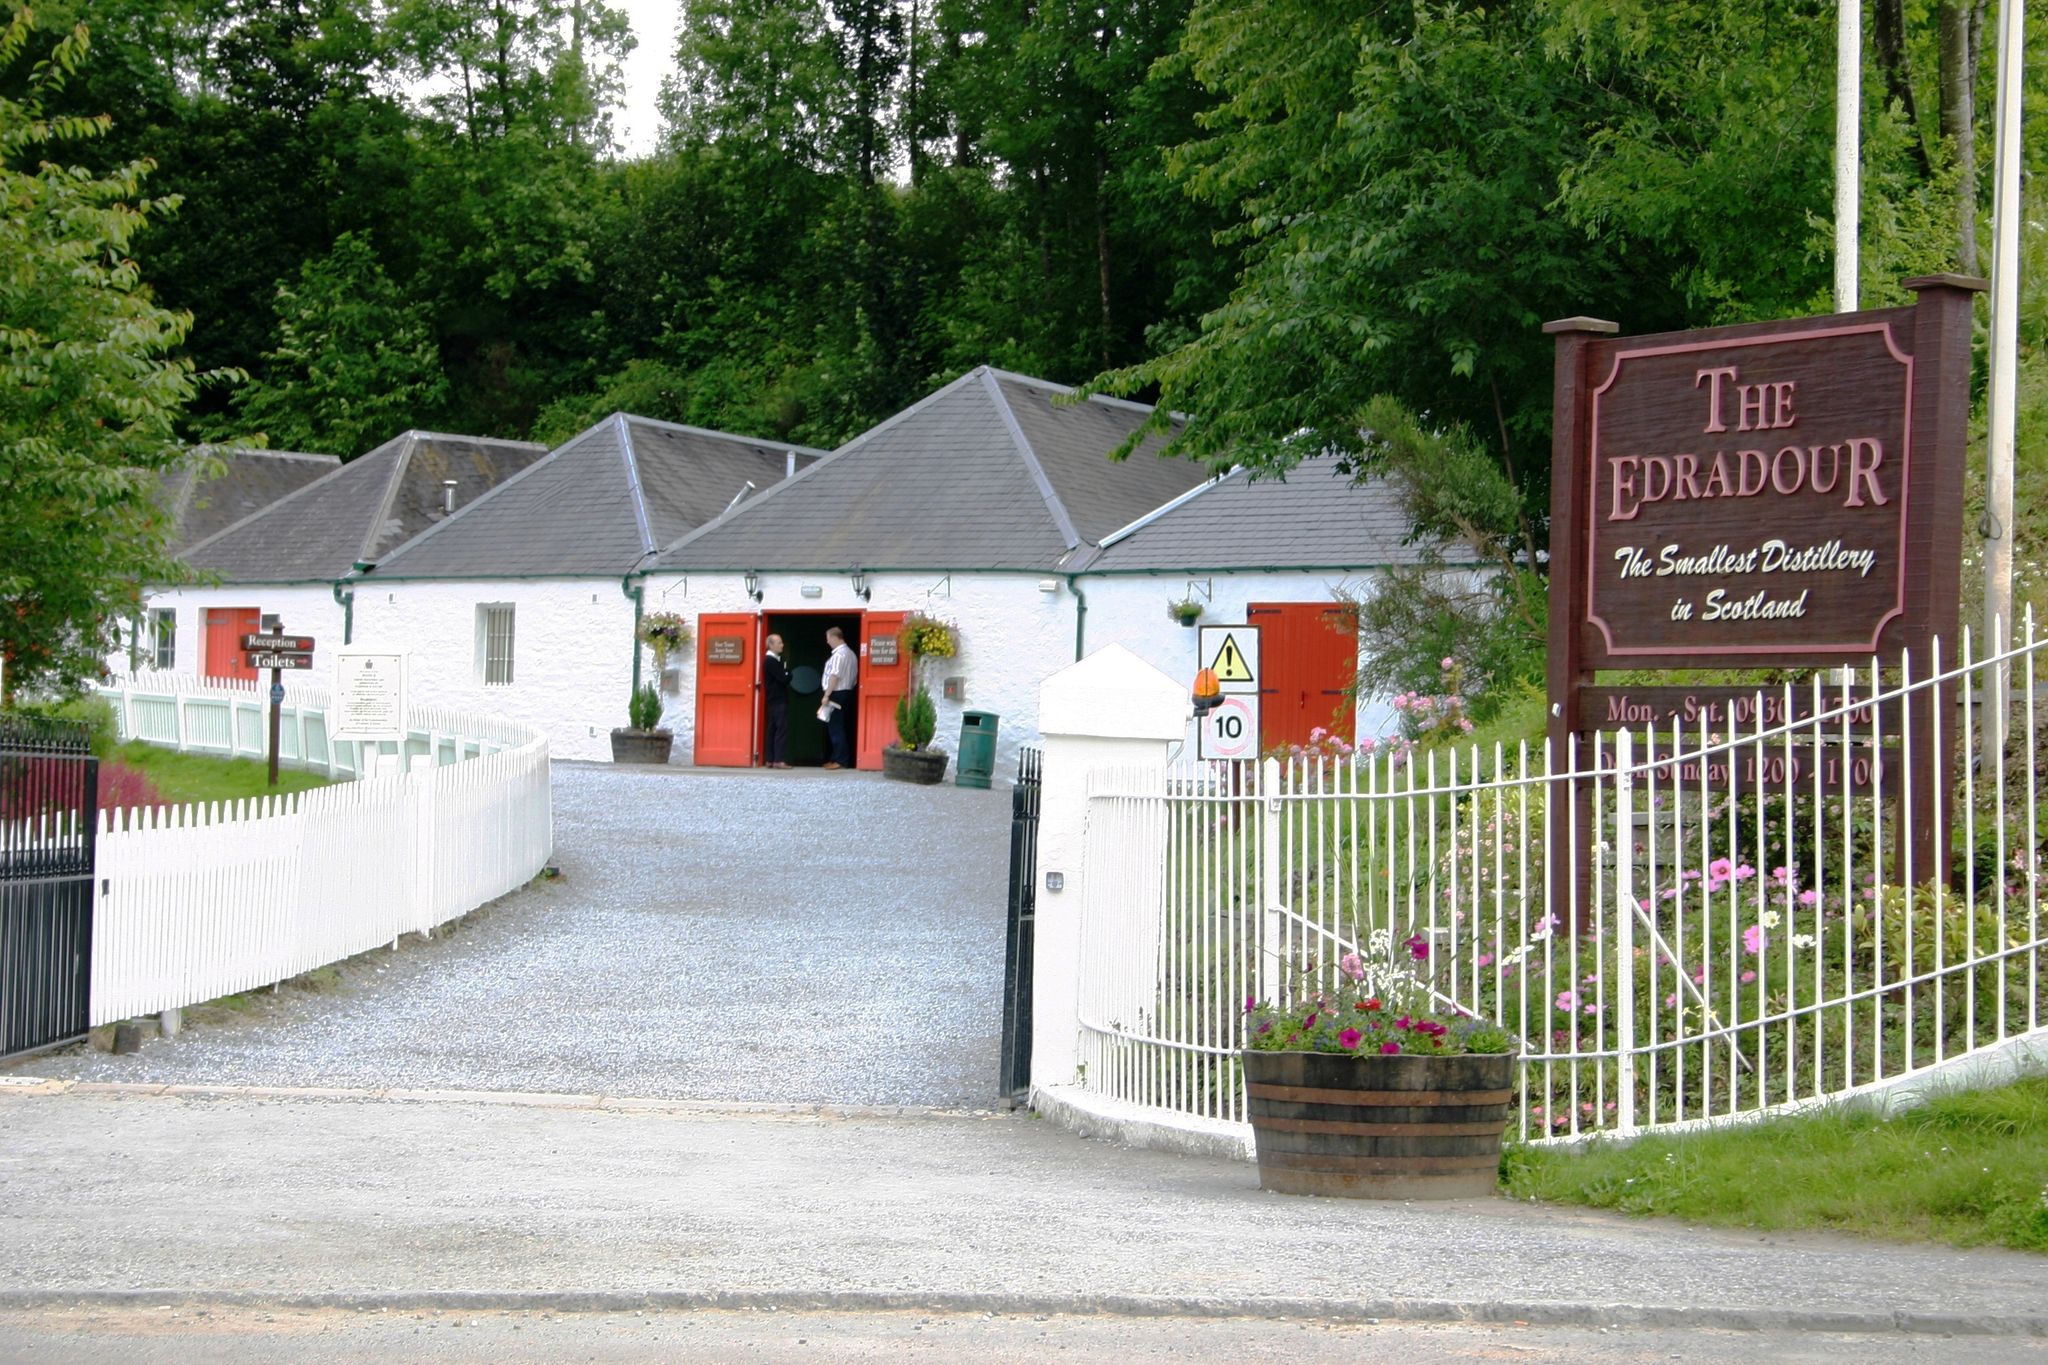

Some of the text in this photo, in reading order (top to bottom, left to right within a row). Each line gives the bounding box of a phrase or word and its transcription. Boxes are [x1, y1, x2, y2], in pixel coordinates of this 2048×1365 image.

[1695, 366, 1797, 434] THE
[1608, 437, 1890, 522] EDRADOUR
[1614, 539, 1876, 579] The Smallest Distillery
[1671, 588, 1808, 622] in Scotland
[248, 634, 297, 649] Reception
[252, 653, 296, 668] Toilets
[1607, 695, 1659, 722] Mon.
[1215, 715, 1243, 739] 10
[1599, 751, 1648, 784] On
[1827, 758, 1884, 786] 100
